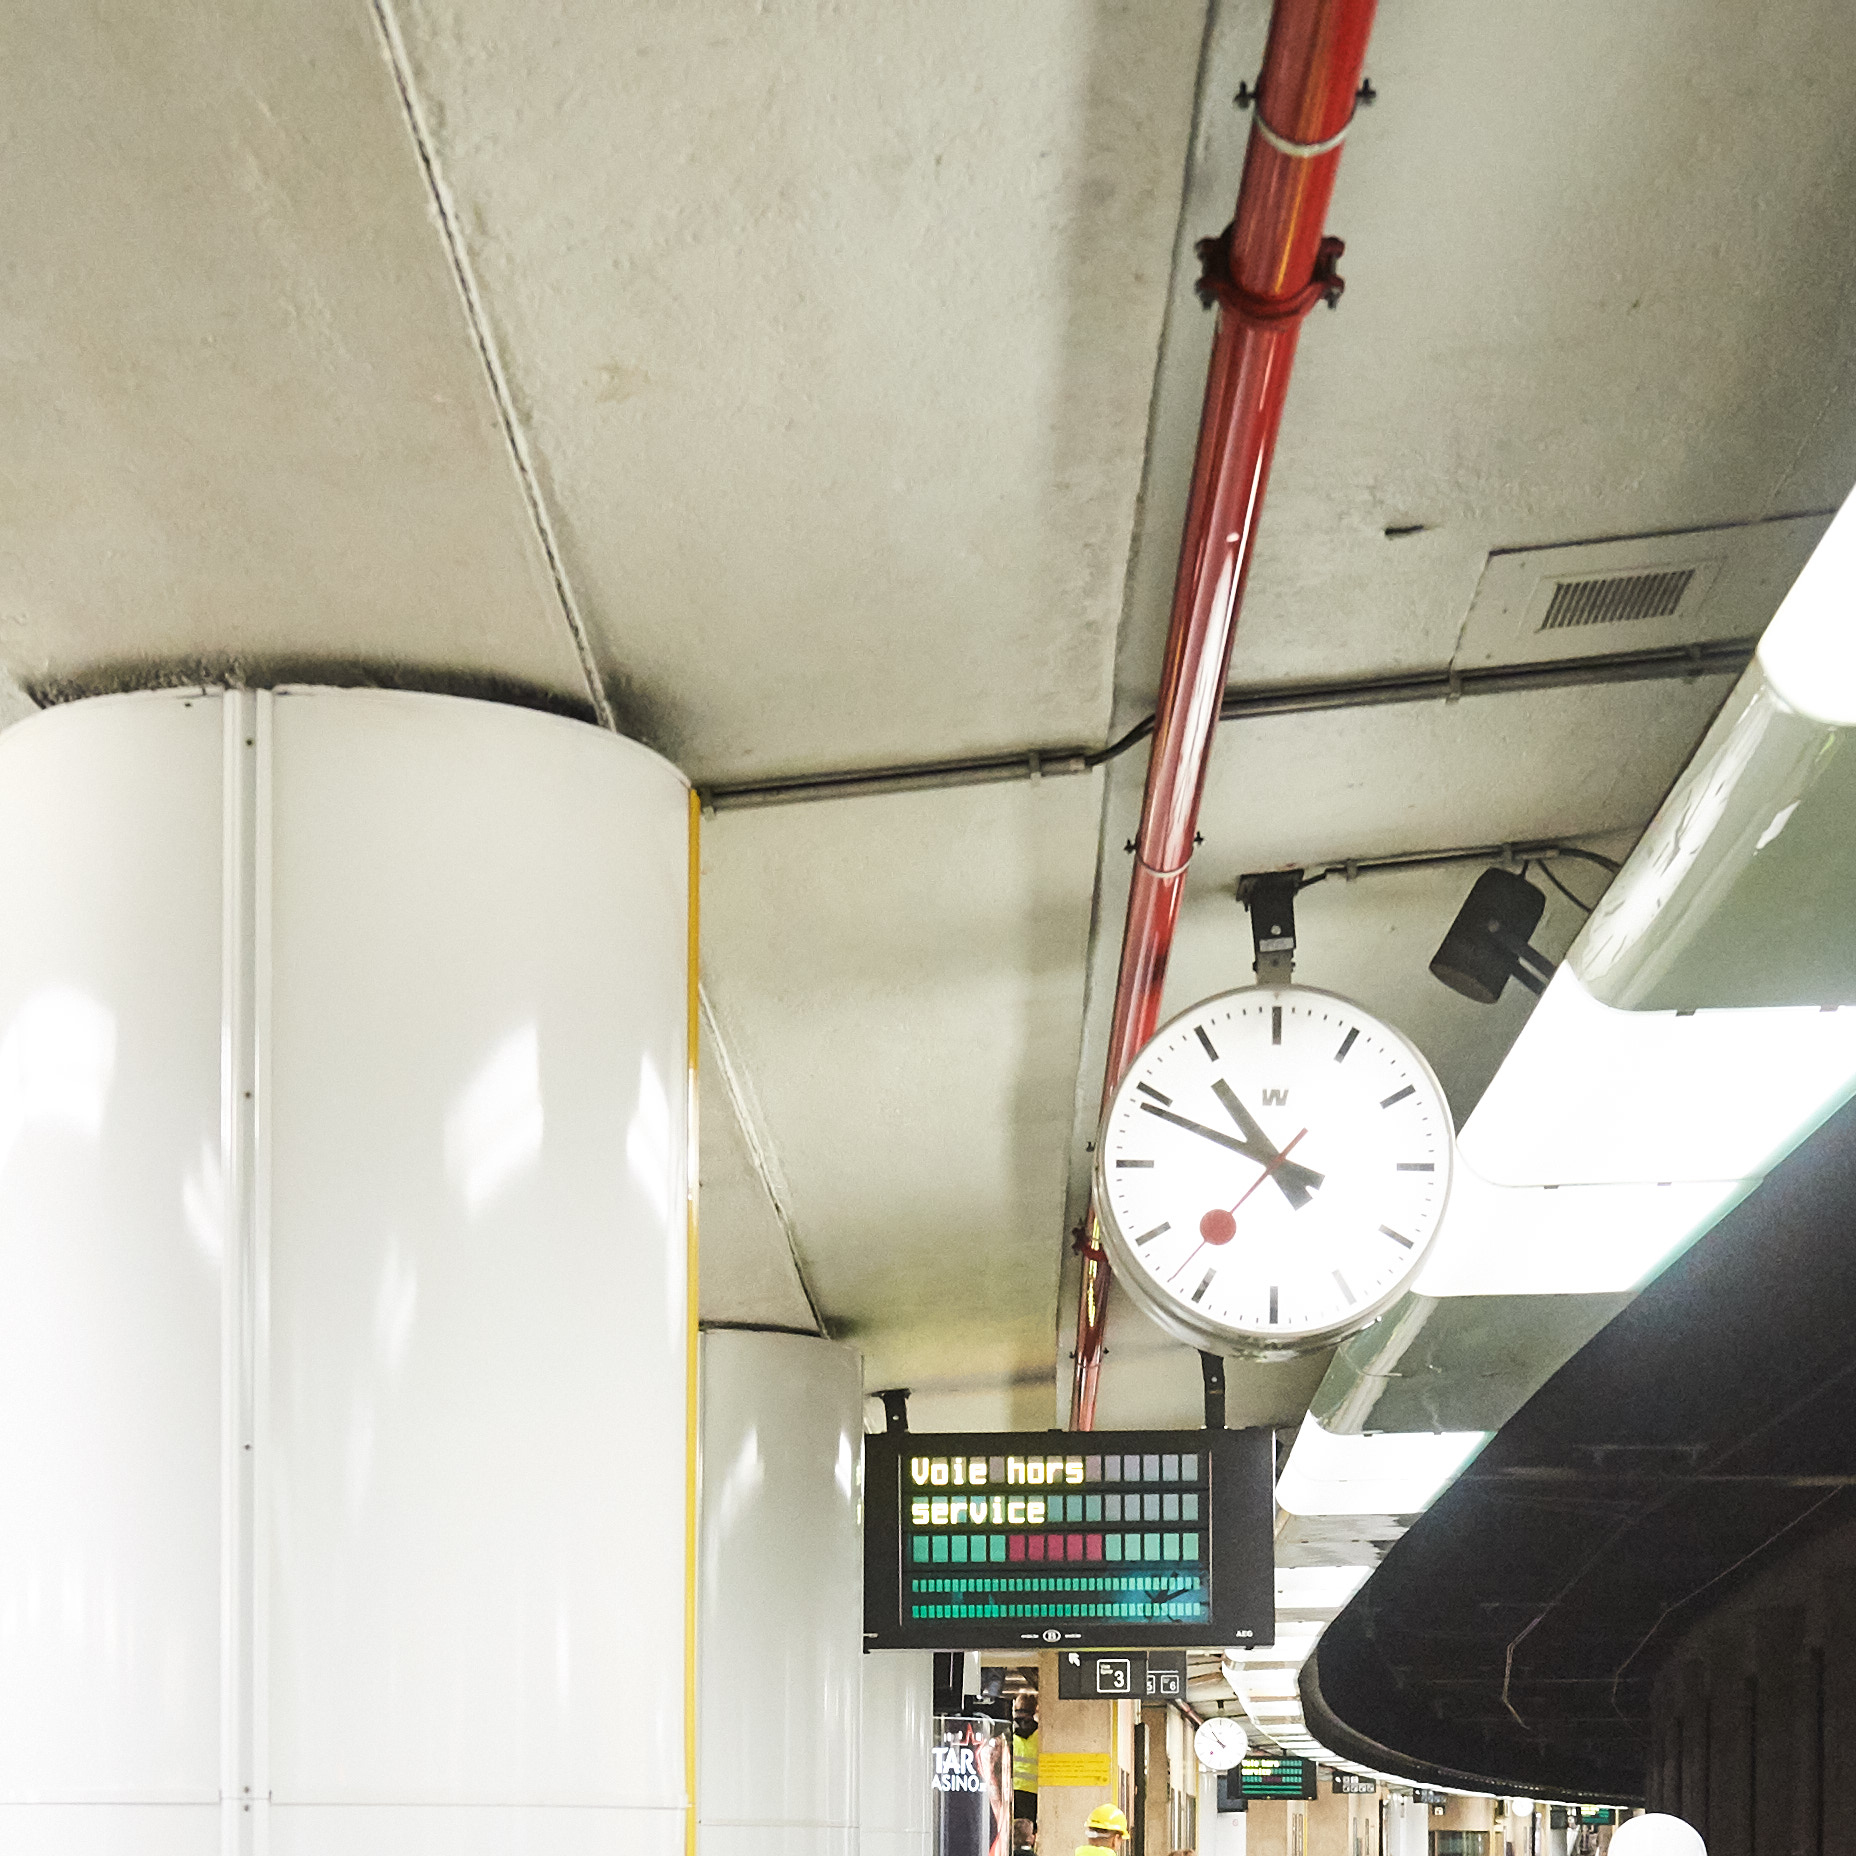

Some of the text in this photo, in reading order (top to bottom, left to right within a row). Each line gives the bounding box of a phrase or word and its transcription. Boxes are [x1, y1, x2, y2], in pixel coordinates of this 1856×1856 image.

[911, 1456, 1085, 1485] Voie hors
[911, 1496, 1045, 1524] service
[1113, 1670, 1125, 1688] 3
[1169, 1681, 1177, 1691] 6
[931, 1747, 976, 1775] TAR
[931, 1774, 981, 1793] ASINO
